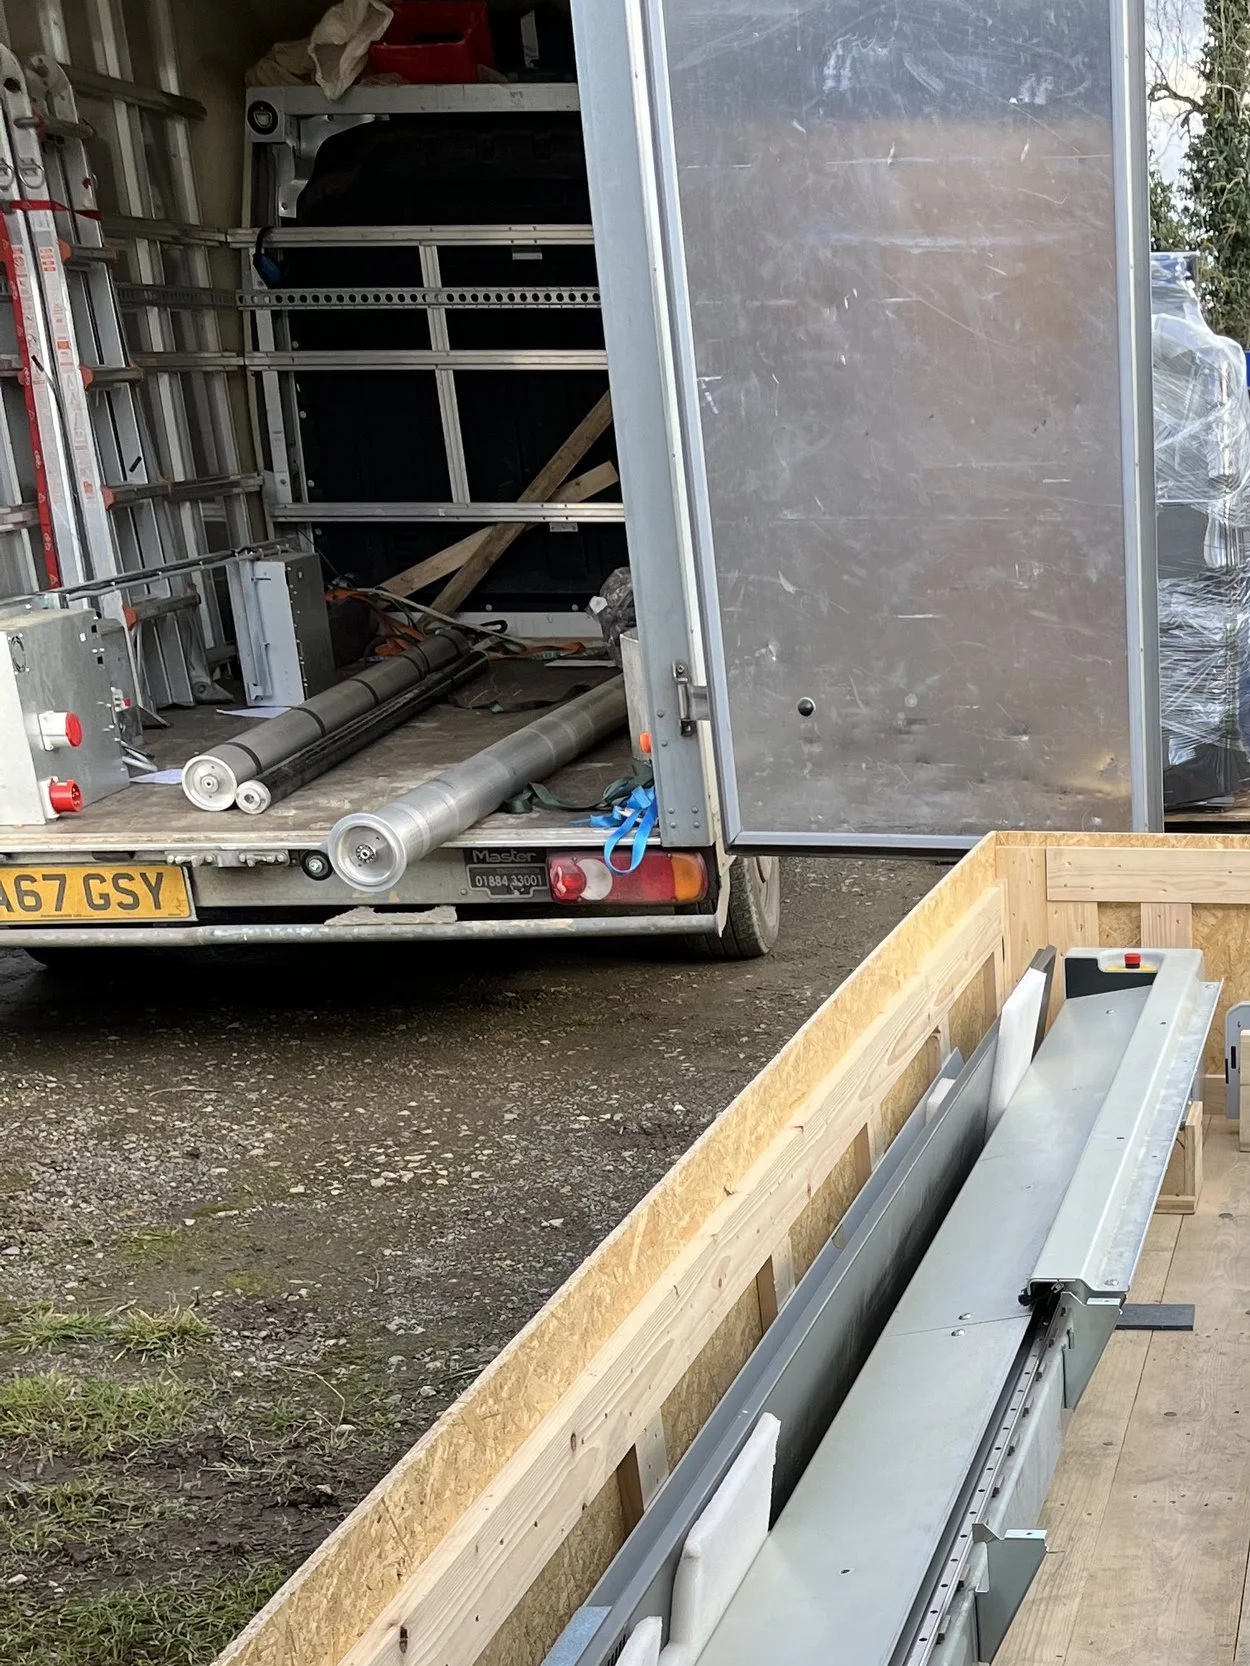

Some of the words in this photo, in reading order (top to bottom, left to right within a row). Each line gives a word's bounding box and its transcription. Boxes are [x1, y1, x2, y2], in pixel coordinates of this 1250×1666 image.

[472, 849, 537, 863] Master
[475, 875, 508, 887] 01884
[83, 872, 164, 911] GSY
